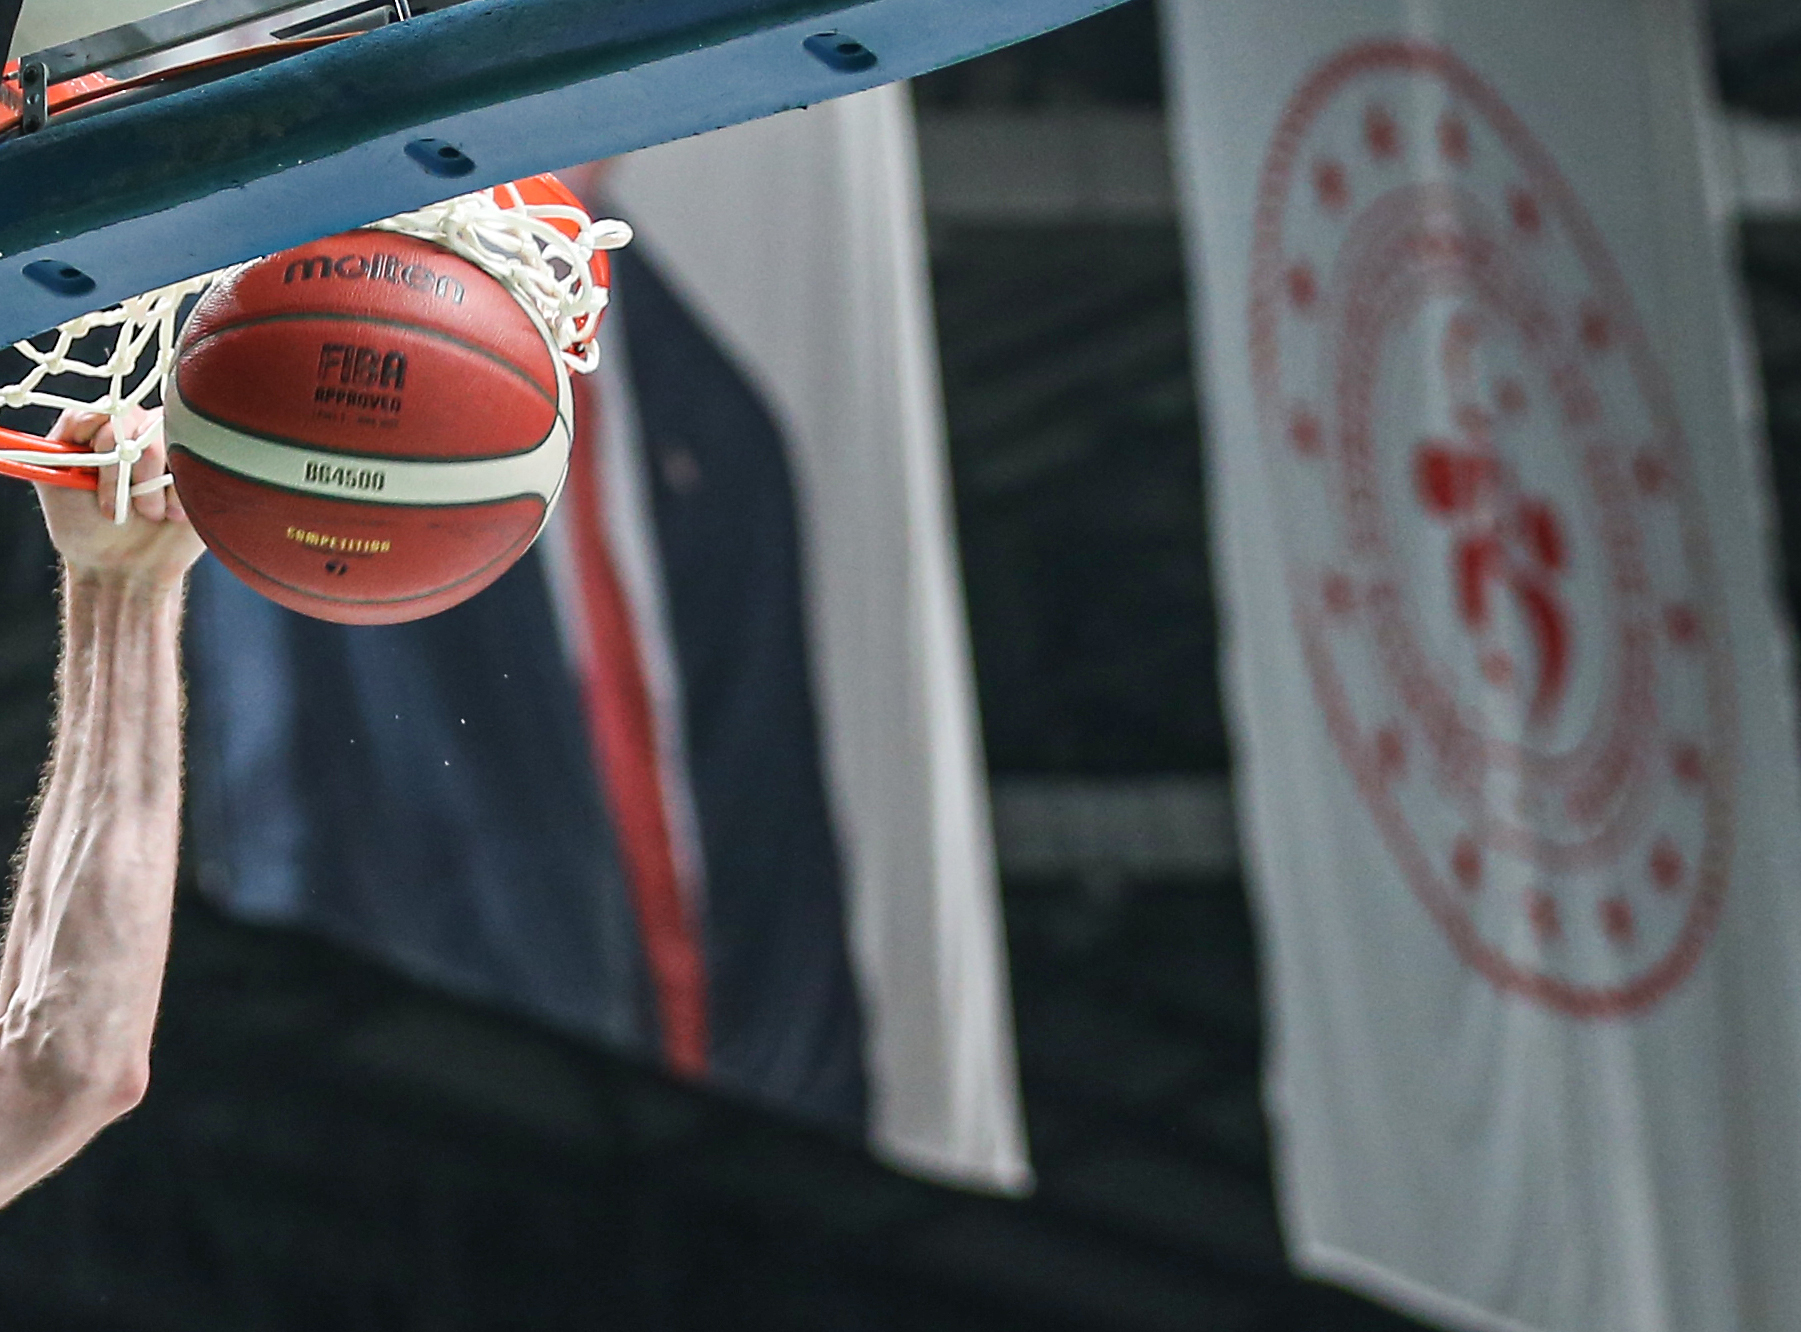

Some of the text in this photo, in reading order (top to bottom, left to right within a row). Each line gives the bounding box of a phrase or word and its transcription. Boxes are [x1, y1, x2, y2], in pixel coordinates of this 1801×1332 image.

[284, 253, 465, 305] molten
[319, 343, 407, 391] FIBA
[314, 386, 401, 412] APPROVED
[304, 460, 385, 492] BG4500
[287, 526, 391, 552] COMPETITION
